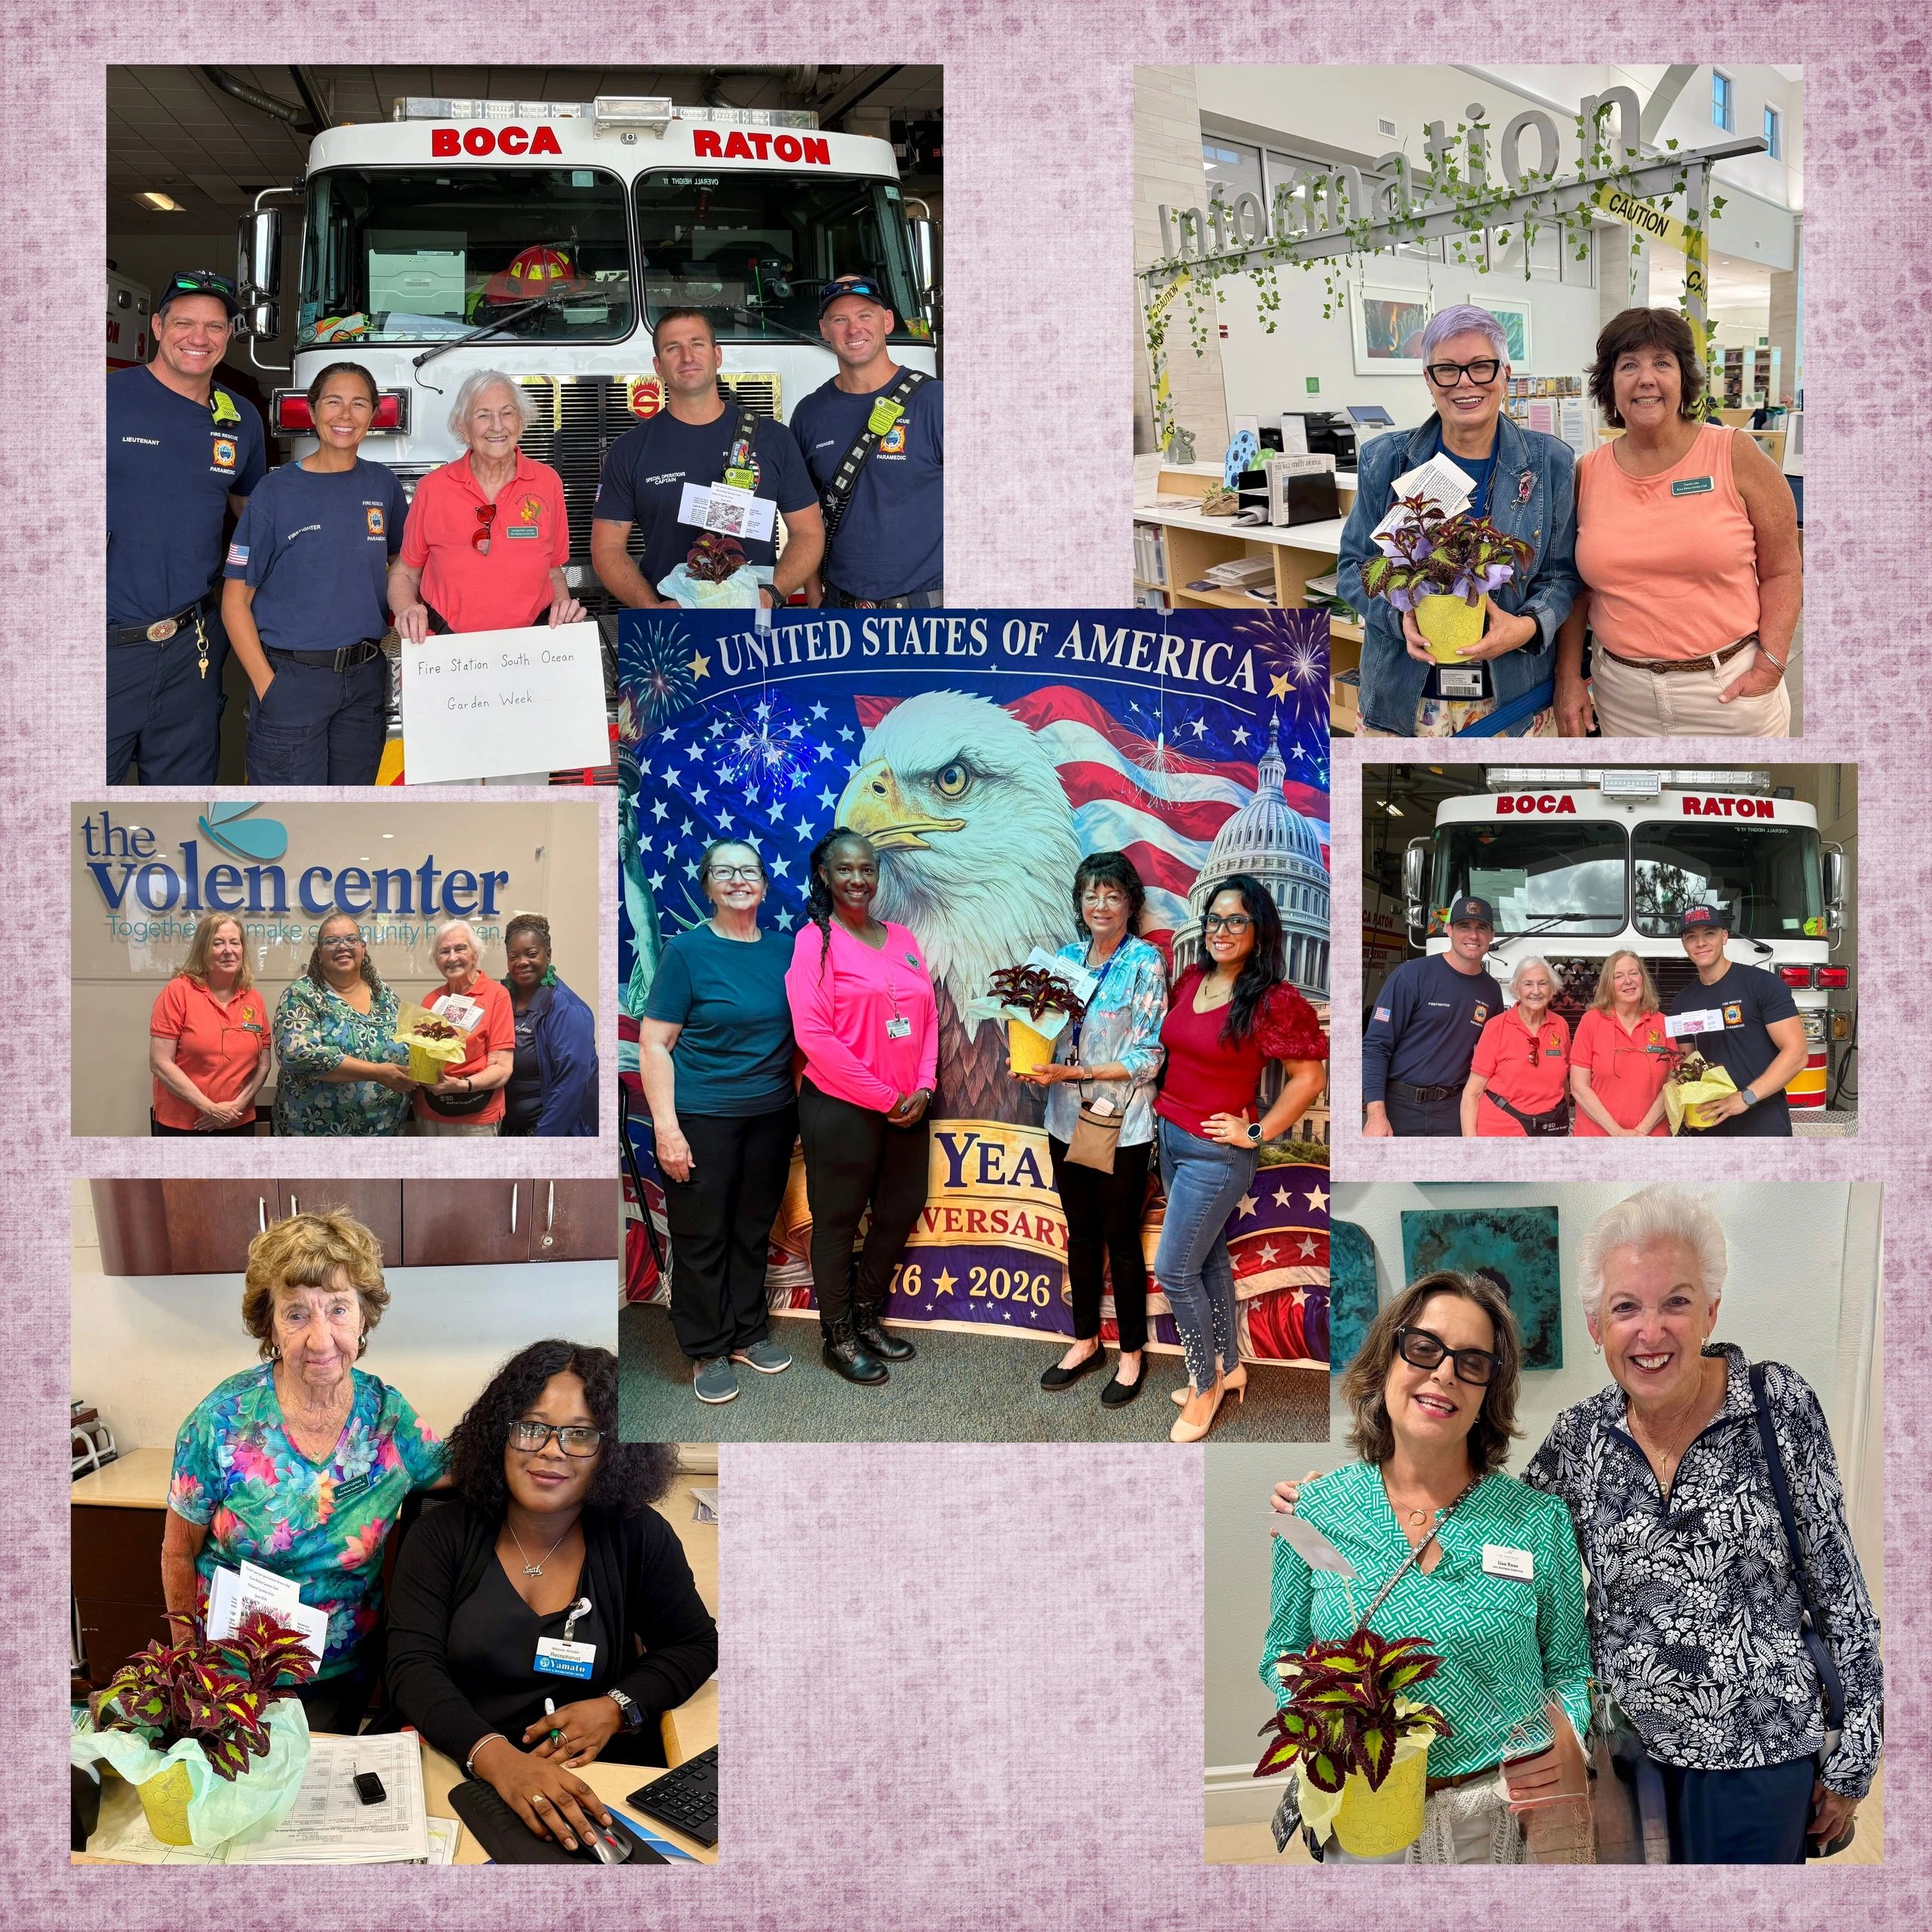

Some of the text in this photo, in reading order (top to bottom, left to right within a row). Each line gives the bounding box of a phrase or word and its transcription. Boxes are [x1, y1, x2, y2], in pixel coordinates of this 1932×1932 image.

[432, 126, 562, 157] BOCA
[693, 129, 831, 165] RATON
[1609, 194, 1669, 237] CAUTION
[1156, 283, 1178, 313] CAUTION
[138, 332, 145, 357] 3
[122, 436, 160, 446] LIEUTENANT
[222, 432, 238, 441] RESCUE
[210, 466, 235, 475] PARAMEDIC
[654, 477, 677, 485] CAPTAIN
[661, 471, 686, 479] OPERATIONS
[288, 525, 321, 540] FIREFIGHTER
[418, 651, 574, 675] Fire Station South Ocean
[715, 617, 1258, 694] UNITED STATES OF AMERICA
[448, 690, 532, 710] Garden Week
[1496, 795, 1577, 814] BOCA
[1683, 797, 1774, 818] RATON
[81, 811, 157, 858] the
[87, 839, 509, 915] volen center
[1685, 909, 1710, 924] FIRE
[106, 915, 196, 942] Togethe
[246, 918, 302, 939] make
[309, 918, 420, 947] cmunity
[969, 1266, 1050, 1307] 2026
[550, 1652, 581, 1661] Receptionist
[550, 1660, 586, 1672] Yamato
